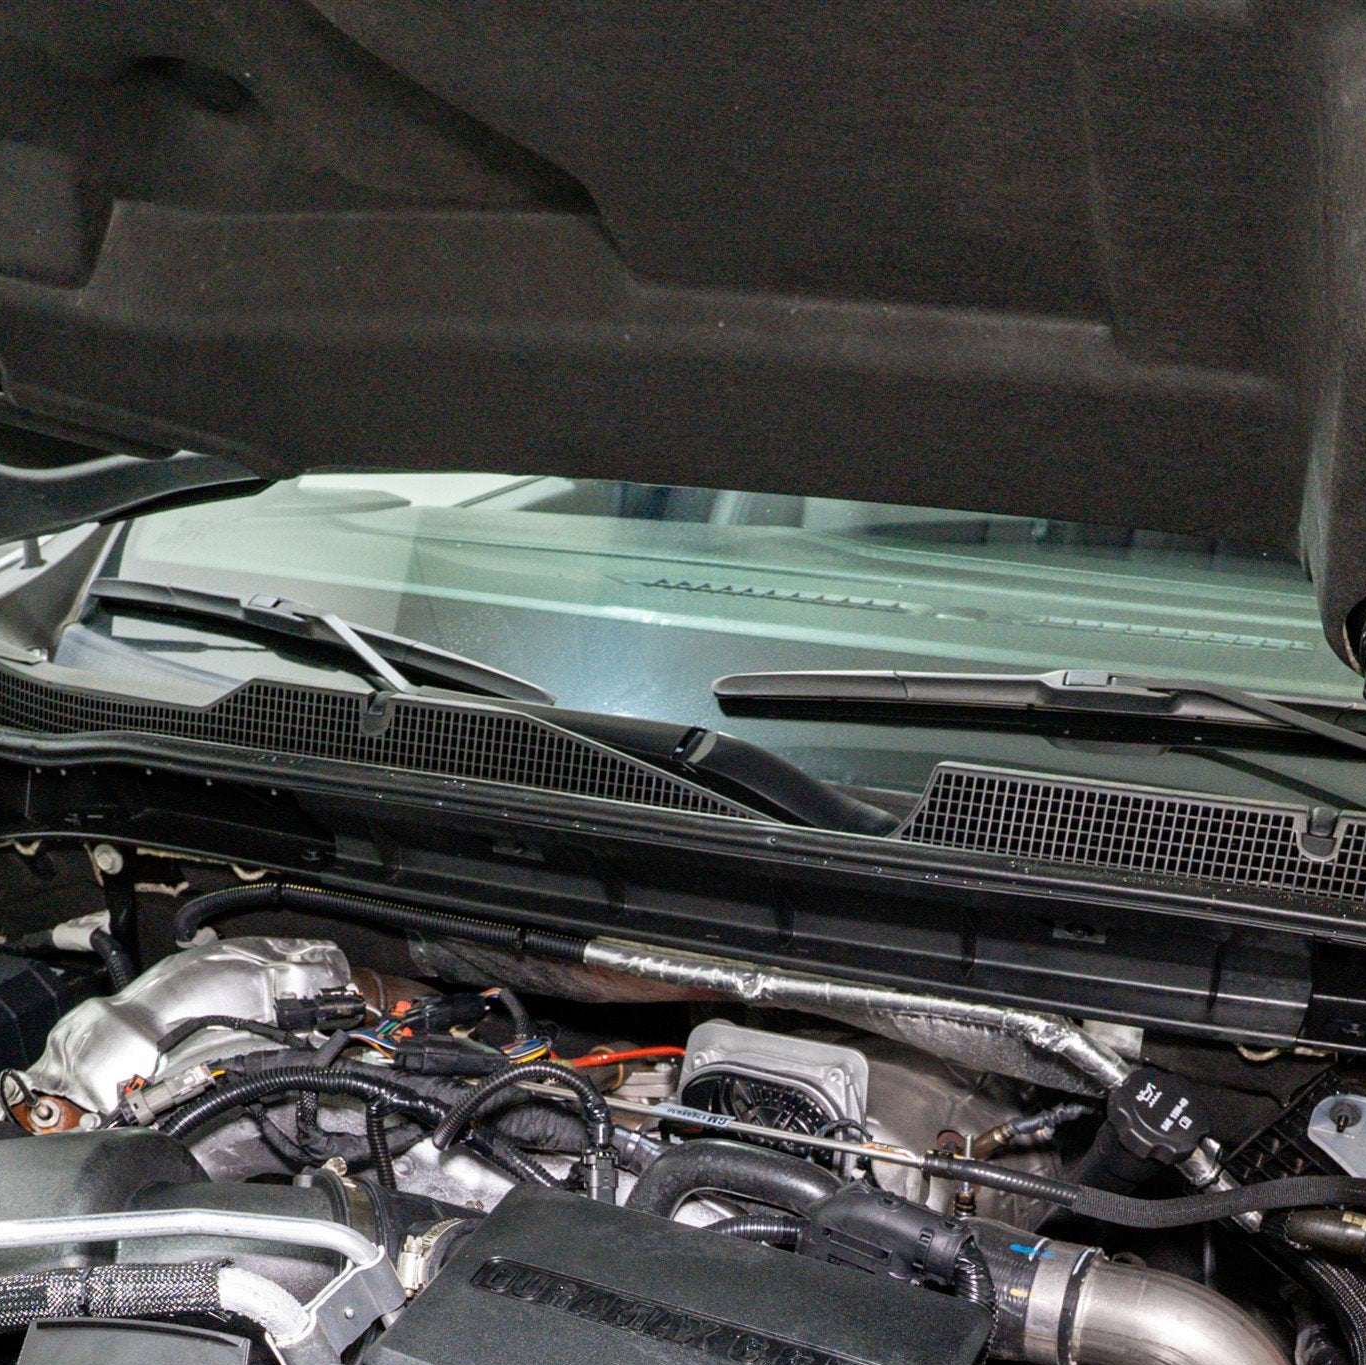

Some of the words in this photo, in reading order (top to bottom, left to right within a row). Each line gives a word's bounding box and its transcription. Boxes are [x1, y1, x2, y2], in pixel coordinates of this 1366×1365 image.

[707, 1116, 728, 1126] GM
[1160, 1117, 1174, 1132] SAE
[480, 1266, 721, 1351] DURAMAX
